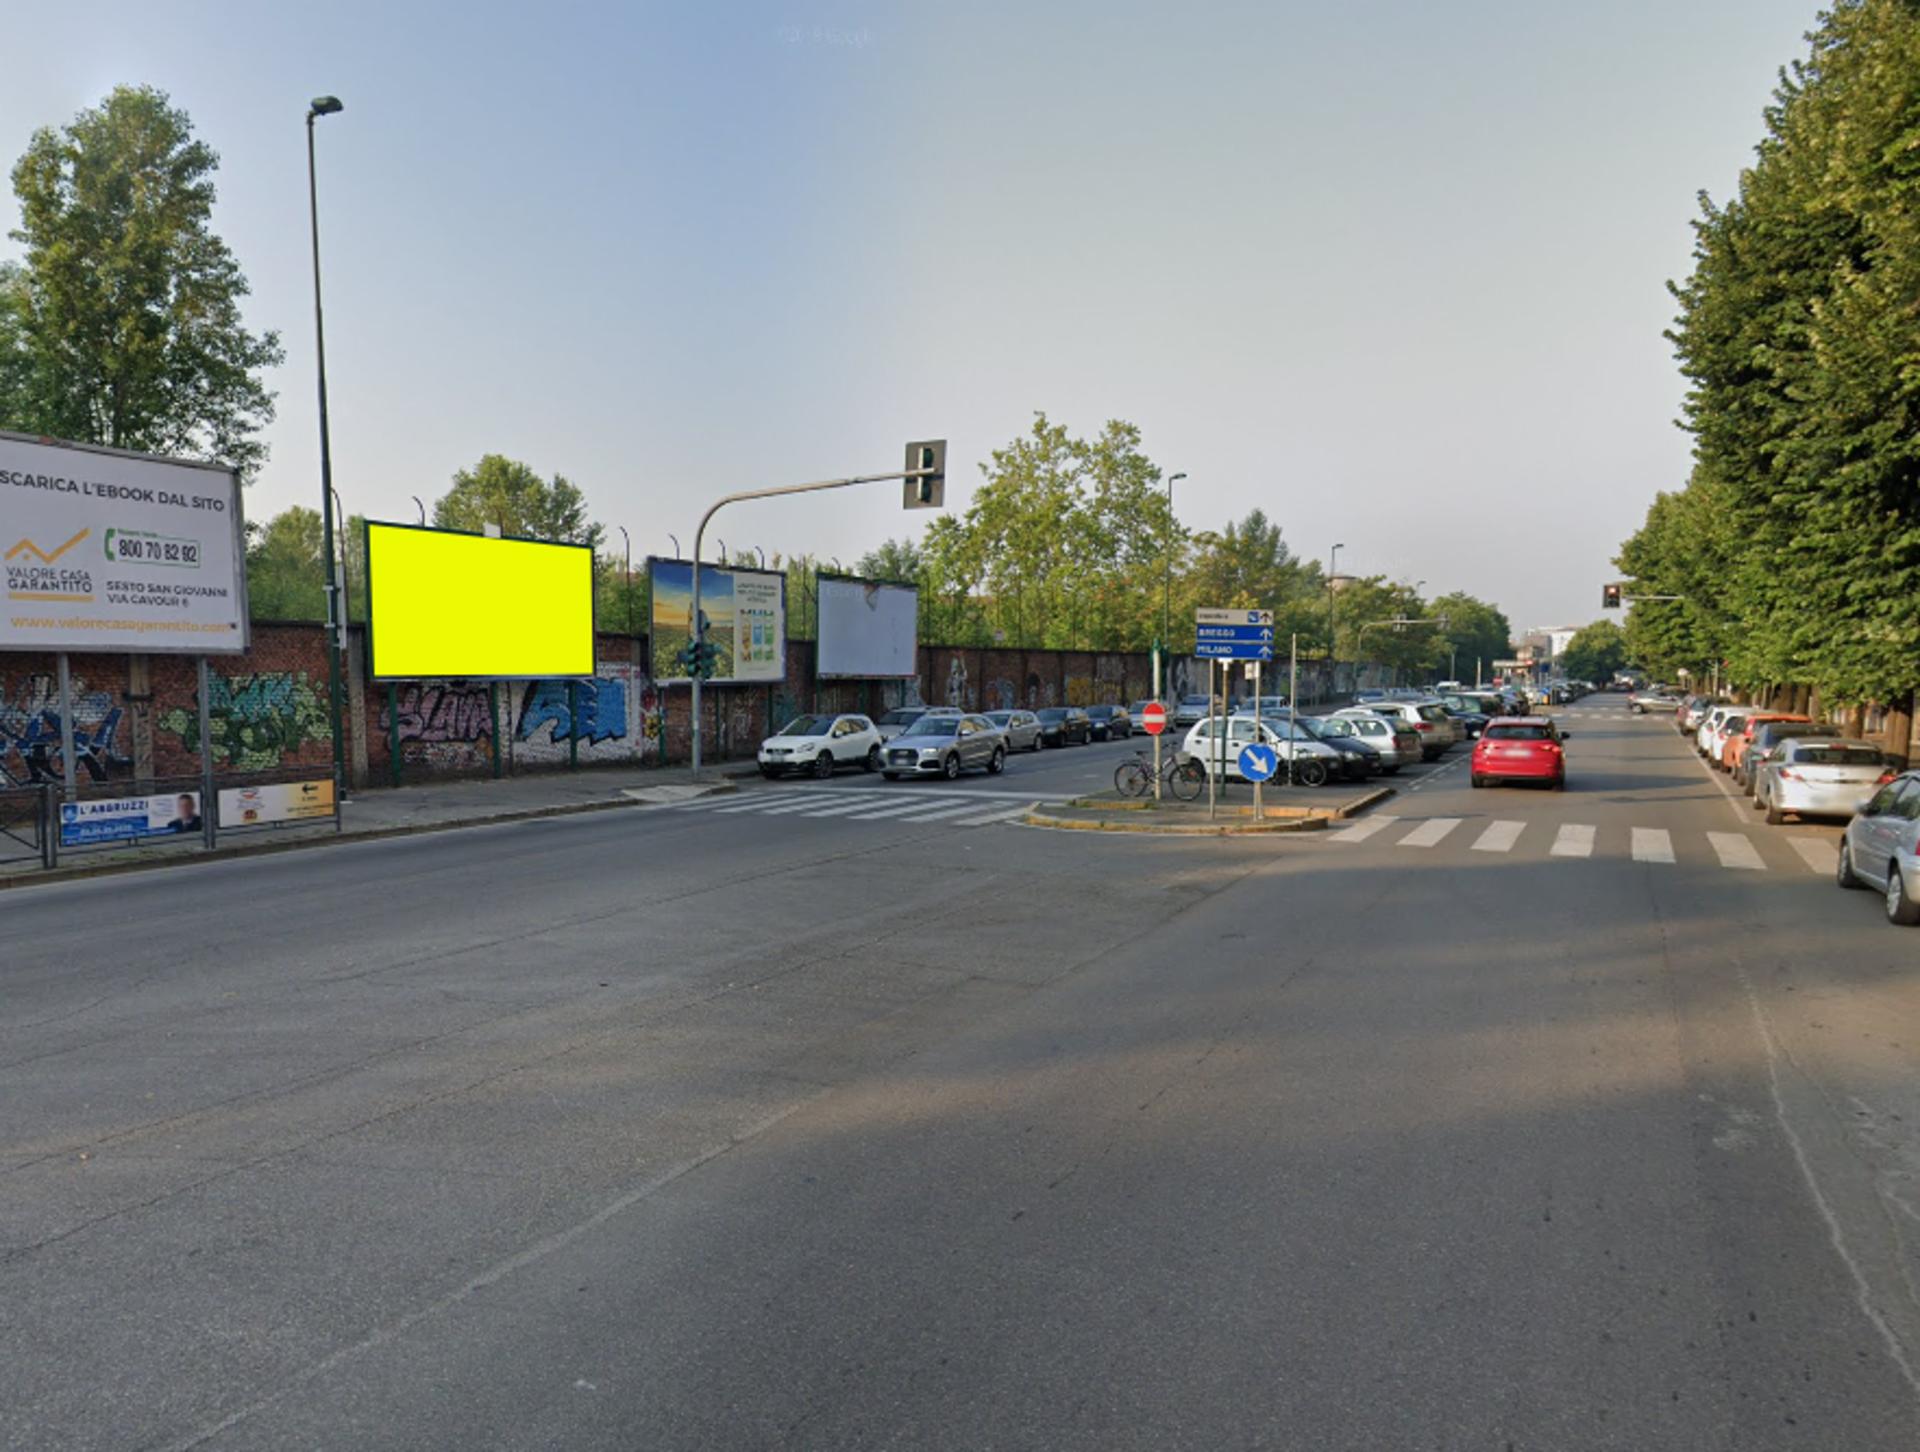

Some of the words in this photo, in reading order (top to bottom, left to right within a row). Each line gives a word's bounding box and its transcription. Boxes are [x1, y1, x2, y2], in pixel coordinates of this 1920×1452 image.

[0, 470, 79, 495] SCARICA
[83, 482, 154, 503] L'EBOOK
[158, 491, 188, 508] DAL
[192, 497, 225, 512] SITO
[119, 538, 142, 558] 800
[146, 541, 161, 560] 70
[6, 566, 56, 580] VALORE
[60, 569, 92, 581] CASA
[8, 578, 93, 593] GARANTITO
[106, 580, 145, 593] SESTO
[147, 583, 170, 595] SAN
[173, 585, 228, 598] GIOVANNI
[107, 593, 129, 605] VIA
[131, 595, 178, 607] CAVOUR
[10, 615, 232, 634] www.valorecasagarantito.com
